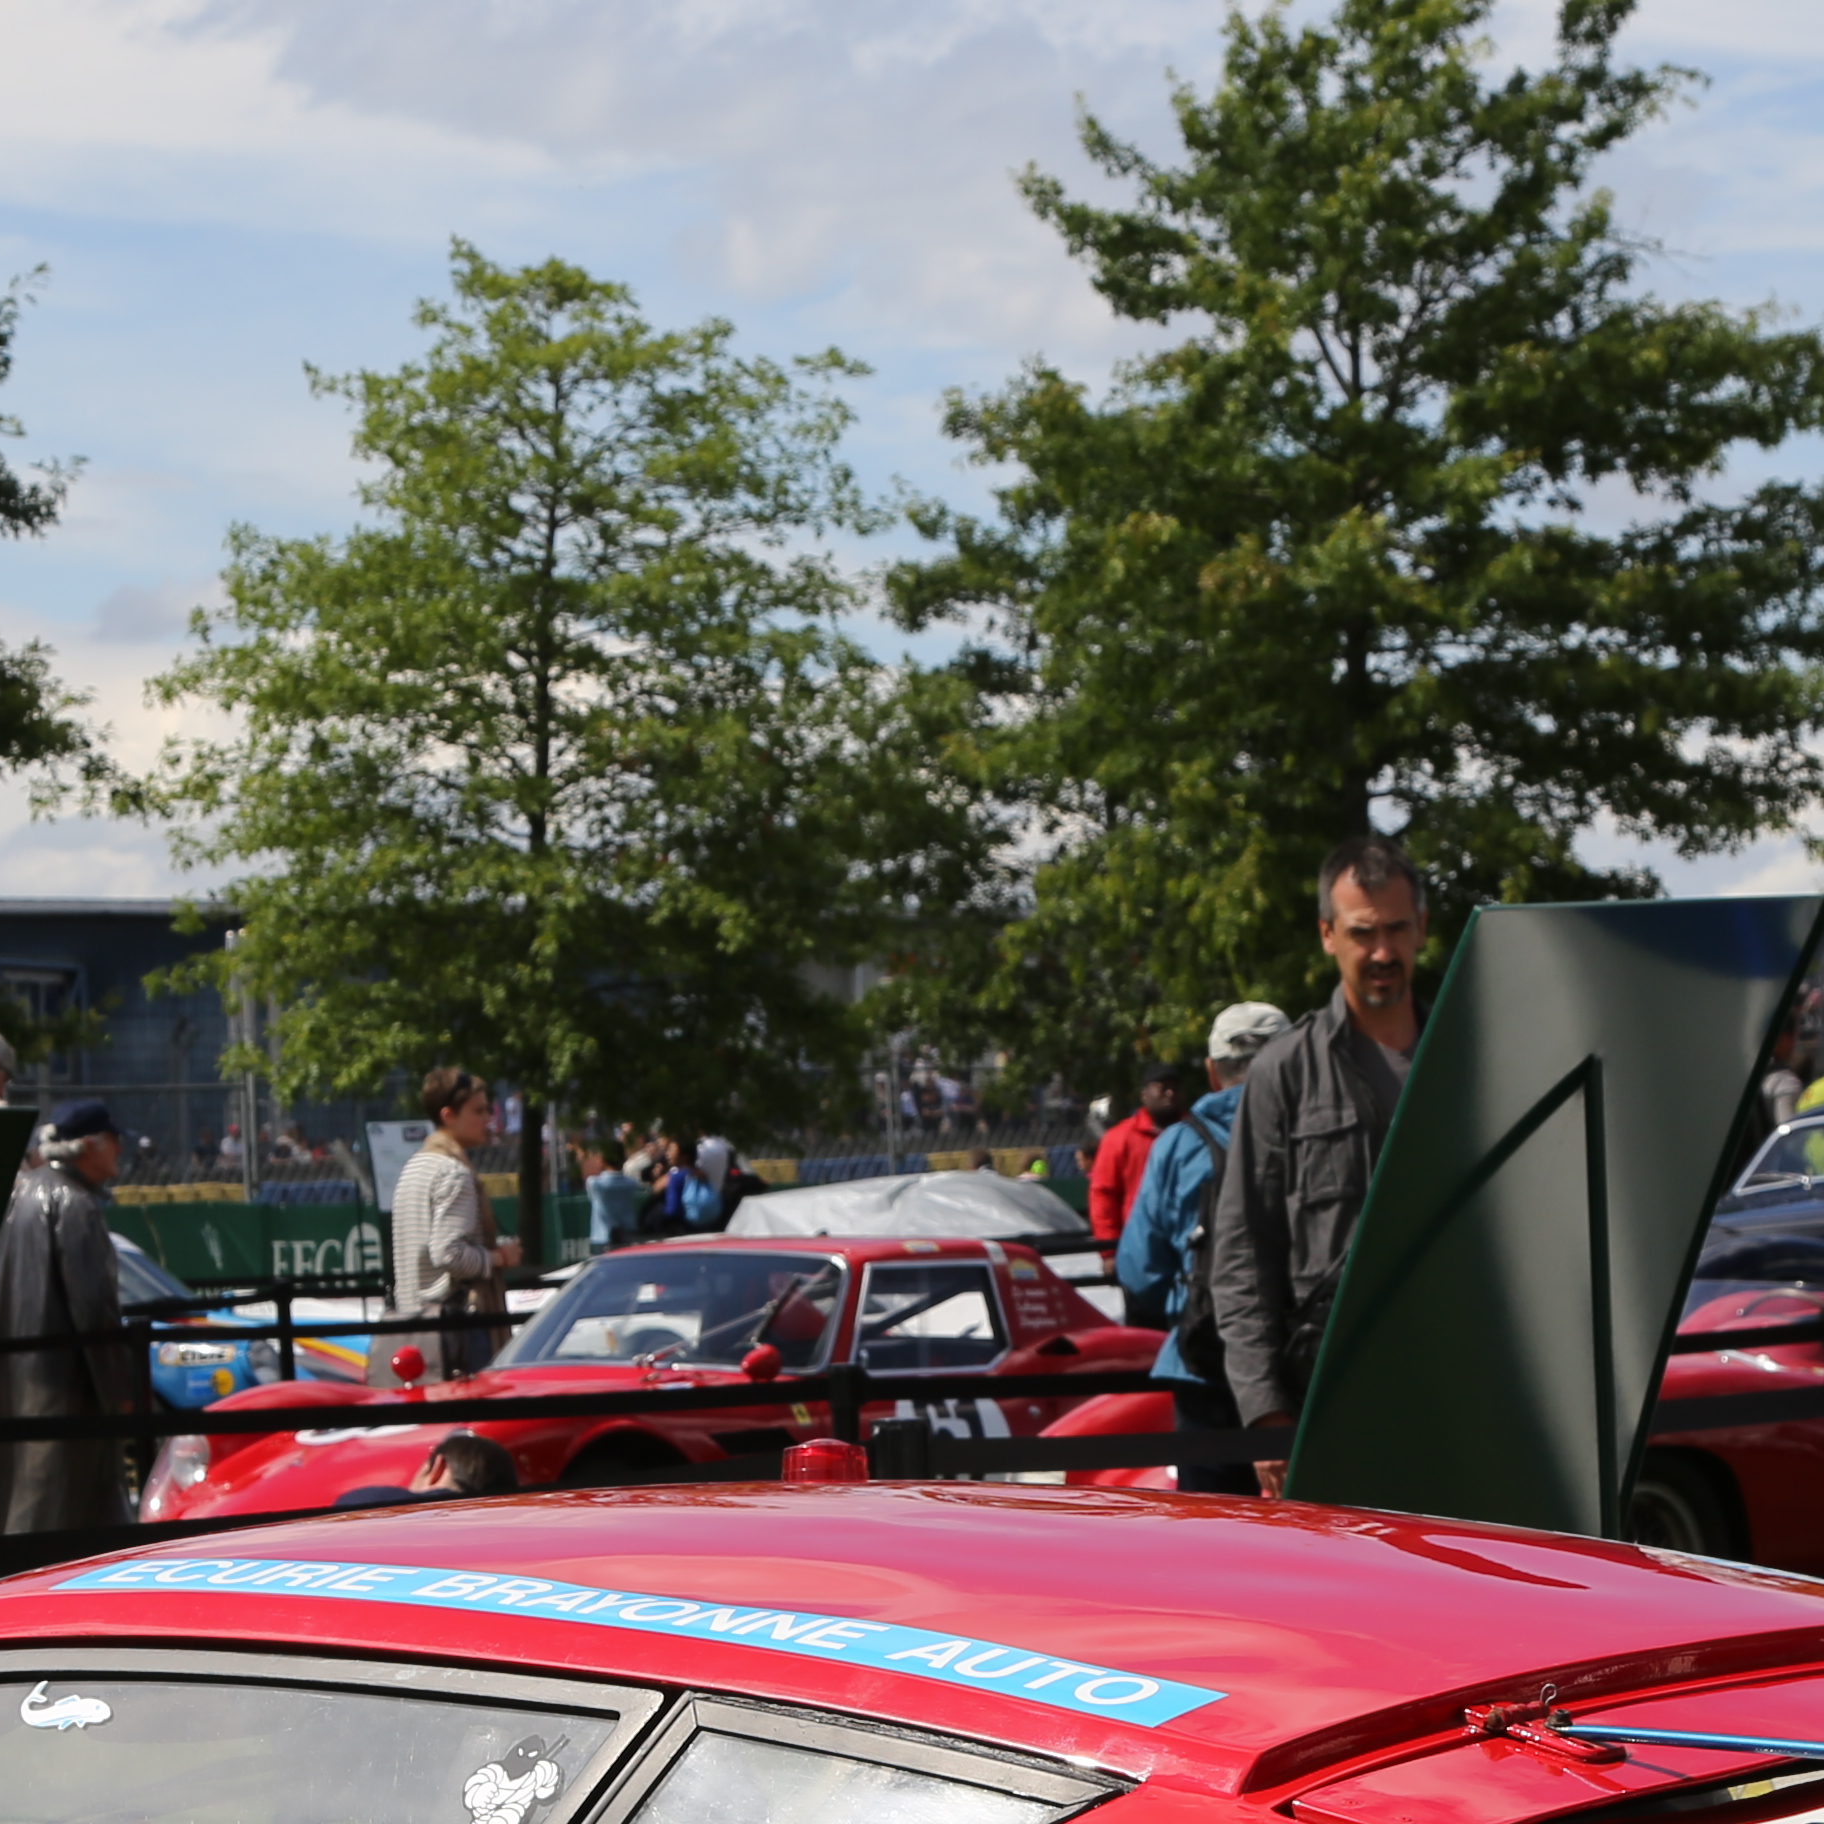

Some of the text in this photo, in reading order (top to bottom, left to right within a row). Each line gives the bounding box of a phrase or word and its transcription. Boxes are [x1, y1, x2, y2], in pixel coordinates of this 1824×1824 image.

[101, 1557, 1166, 1710] ECURIE BRAYONNE AUTO
